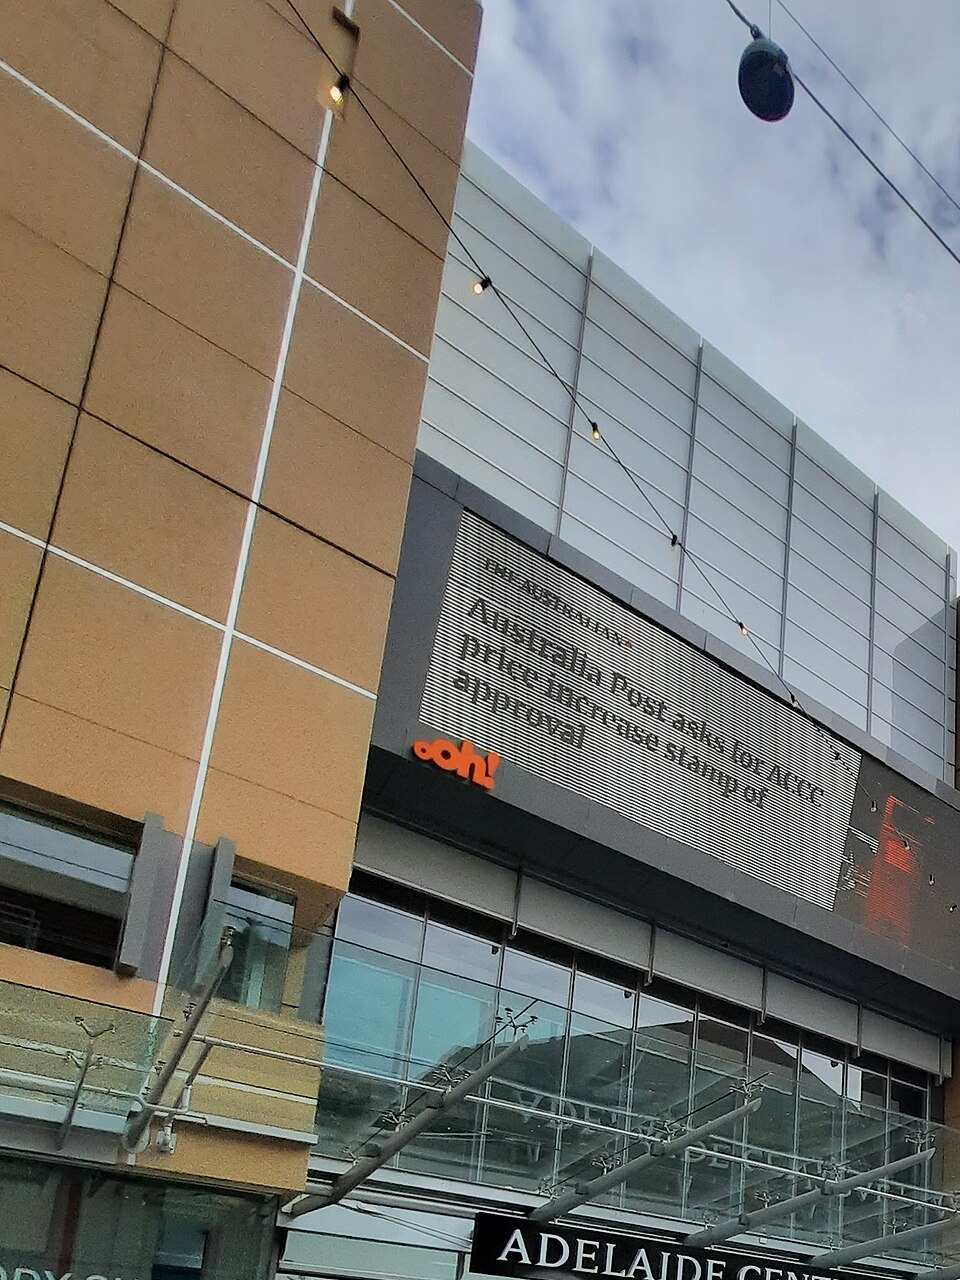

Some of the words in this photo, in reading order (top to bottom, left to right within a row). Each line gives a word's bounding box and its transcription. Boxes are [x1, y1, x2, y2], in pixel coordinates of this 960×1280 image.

[452, 668, 587, 750] approval
[459, 632, 540, 690] price
[544, 671, 660, 753] increase
[664, 741, 739, 800] stamp
[742, 784, 770, 810] of
[467, 597, 603, 688] Australia
[610, 671, 668, 725] Post
[672, 711, 726, 756] asks
[729, 739, 765, 777] for
[766, 763, 826, 809] ACCC
